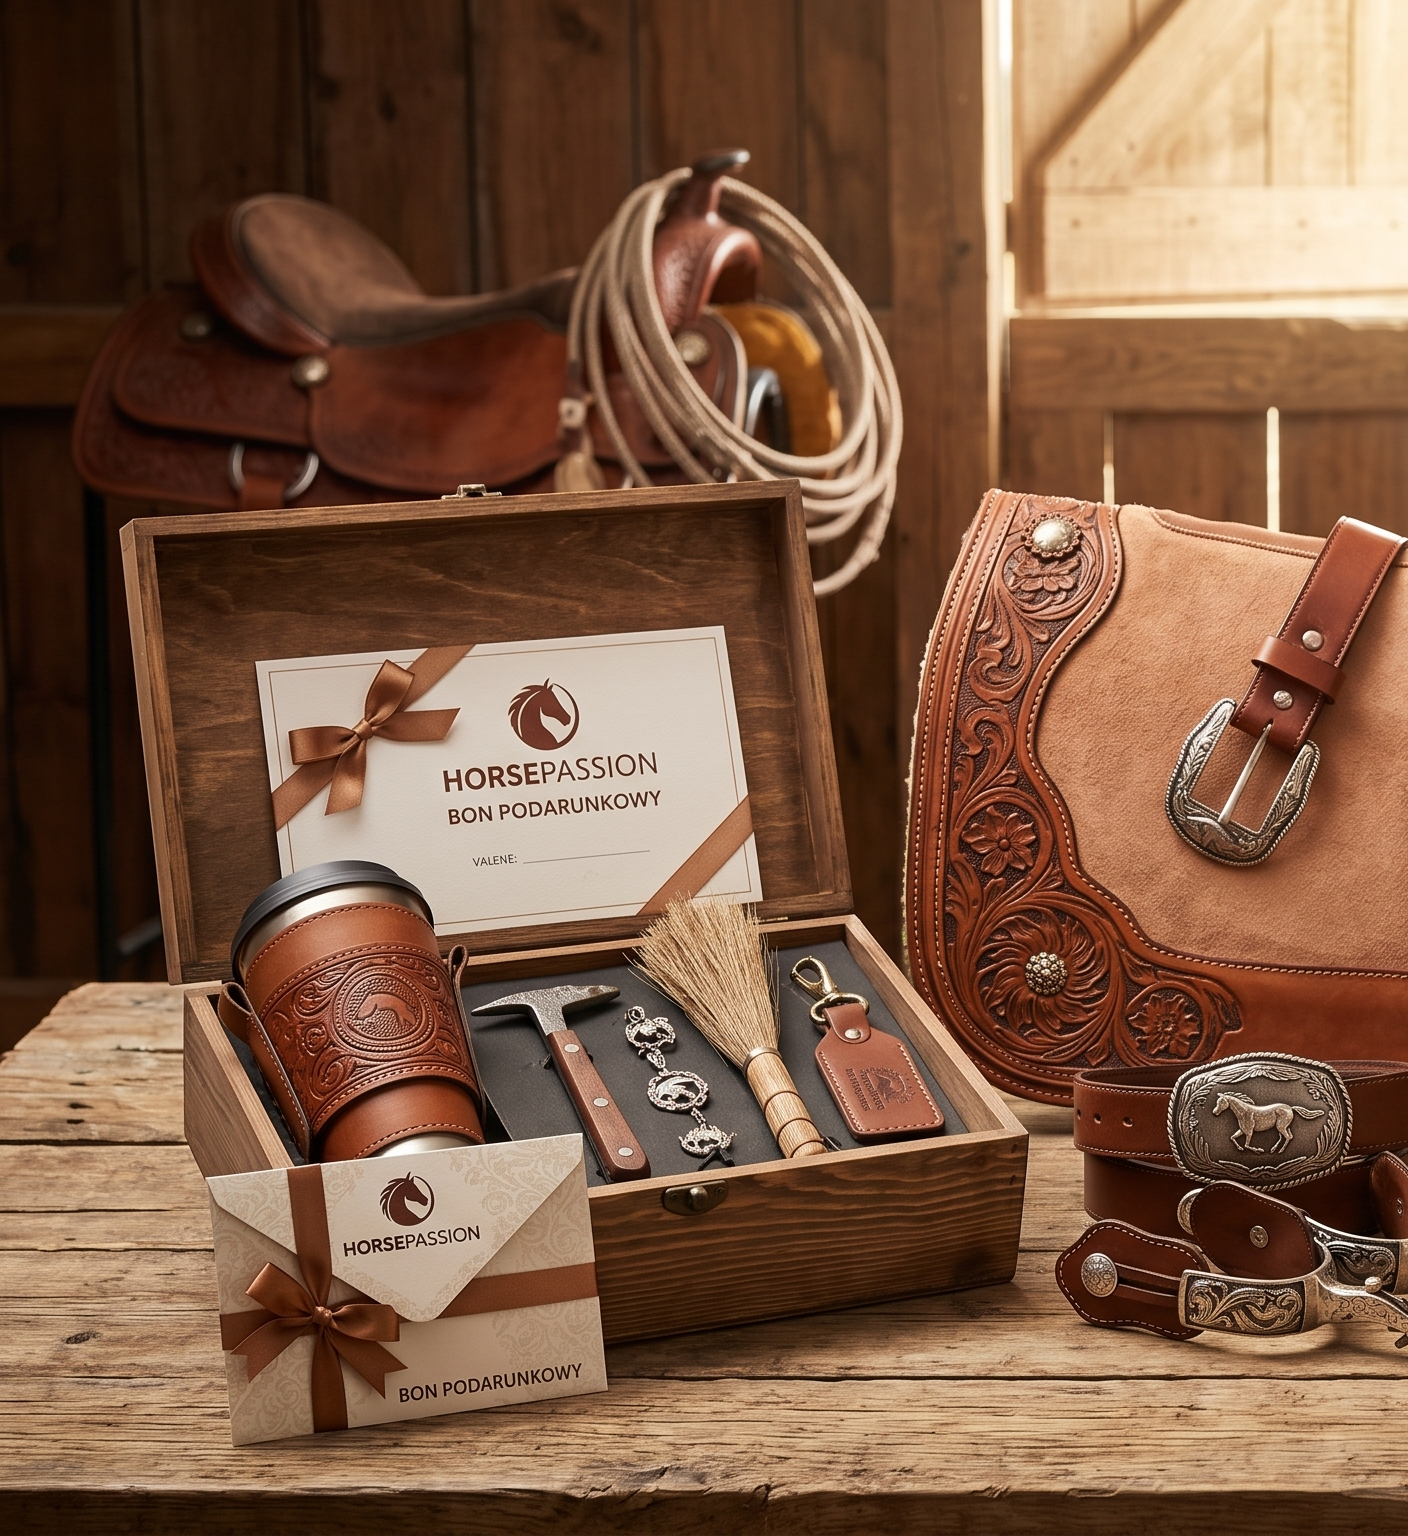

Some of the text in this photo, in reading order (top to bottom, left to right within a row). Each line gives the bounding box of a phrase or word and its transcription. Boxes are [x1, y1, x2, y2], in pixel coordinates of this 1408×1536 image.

[442, 751, 658, 793] HORSEPASSION
[447, 789, 661, 825] BON PODARUNKOWY
[472, 853, 518, 867] VALENE:
[343, 1225, 482, 1257] HORSEPASSION
[398, 1362, 582, 1403] BON PODARUNKOWY
